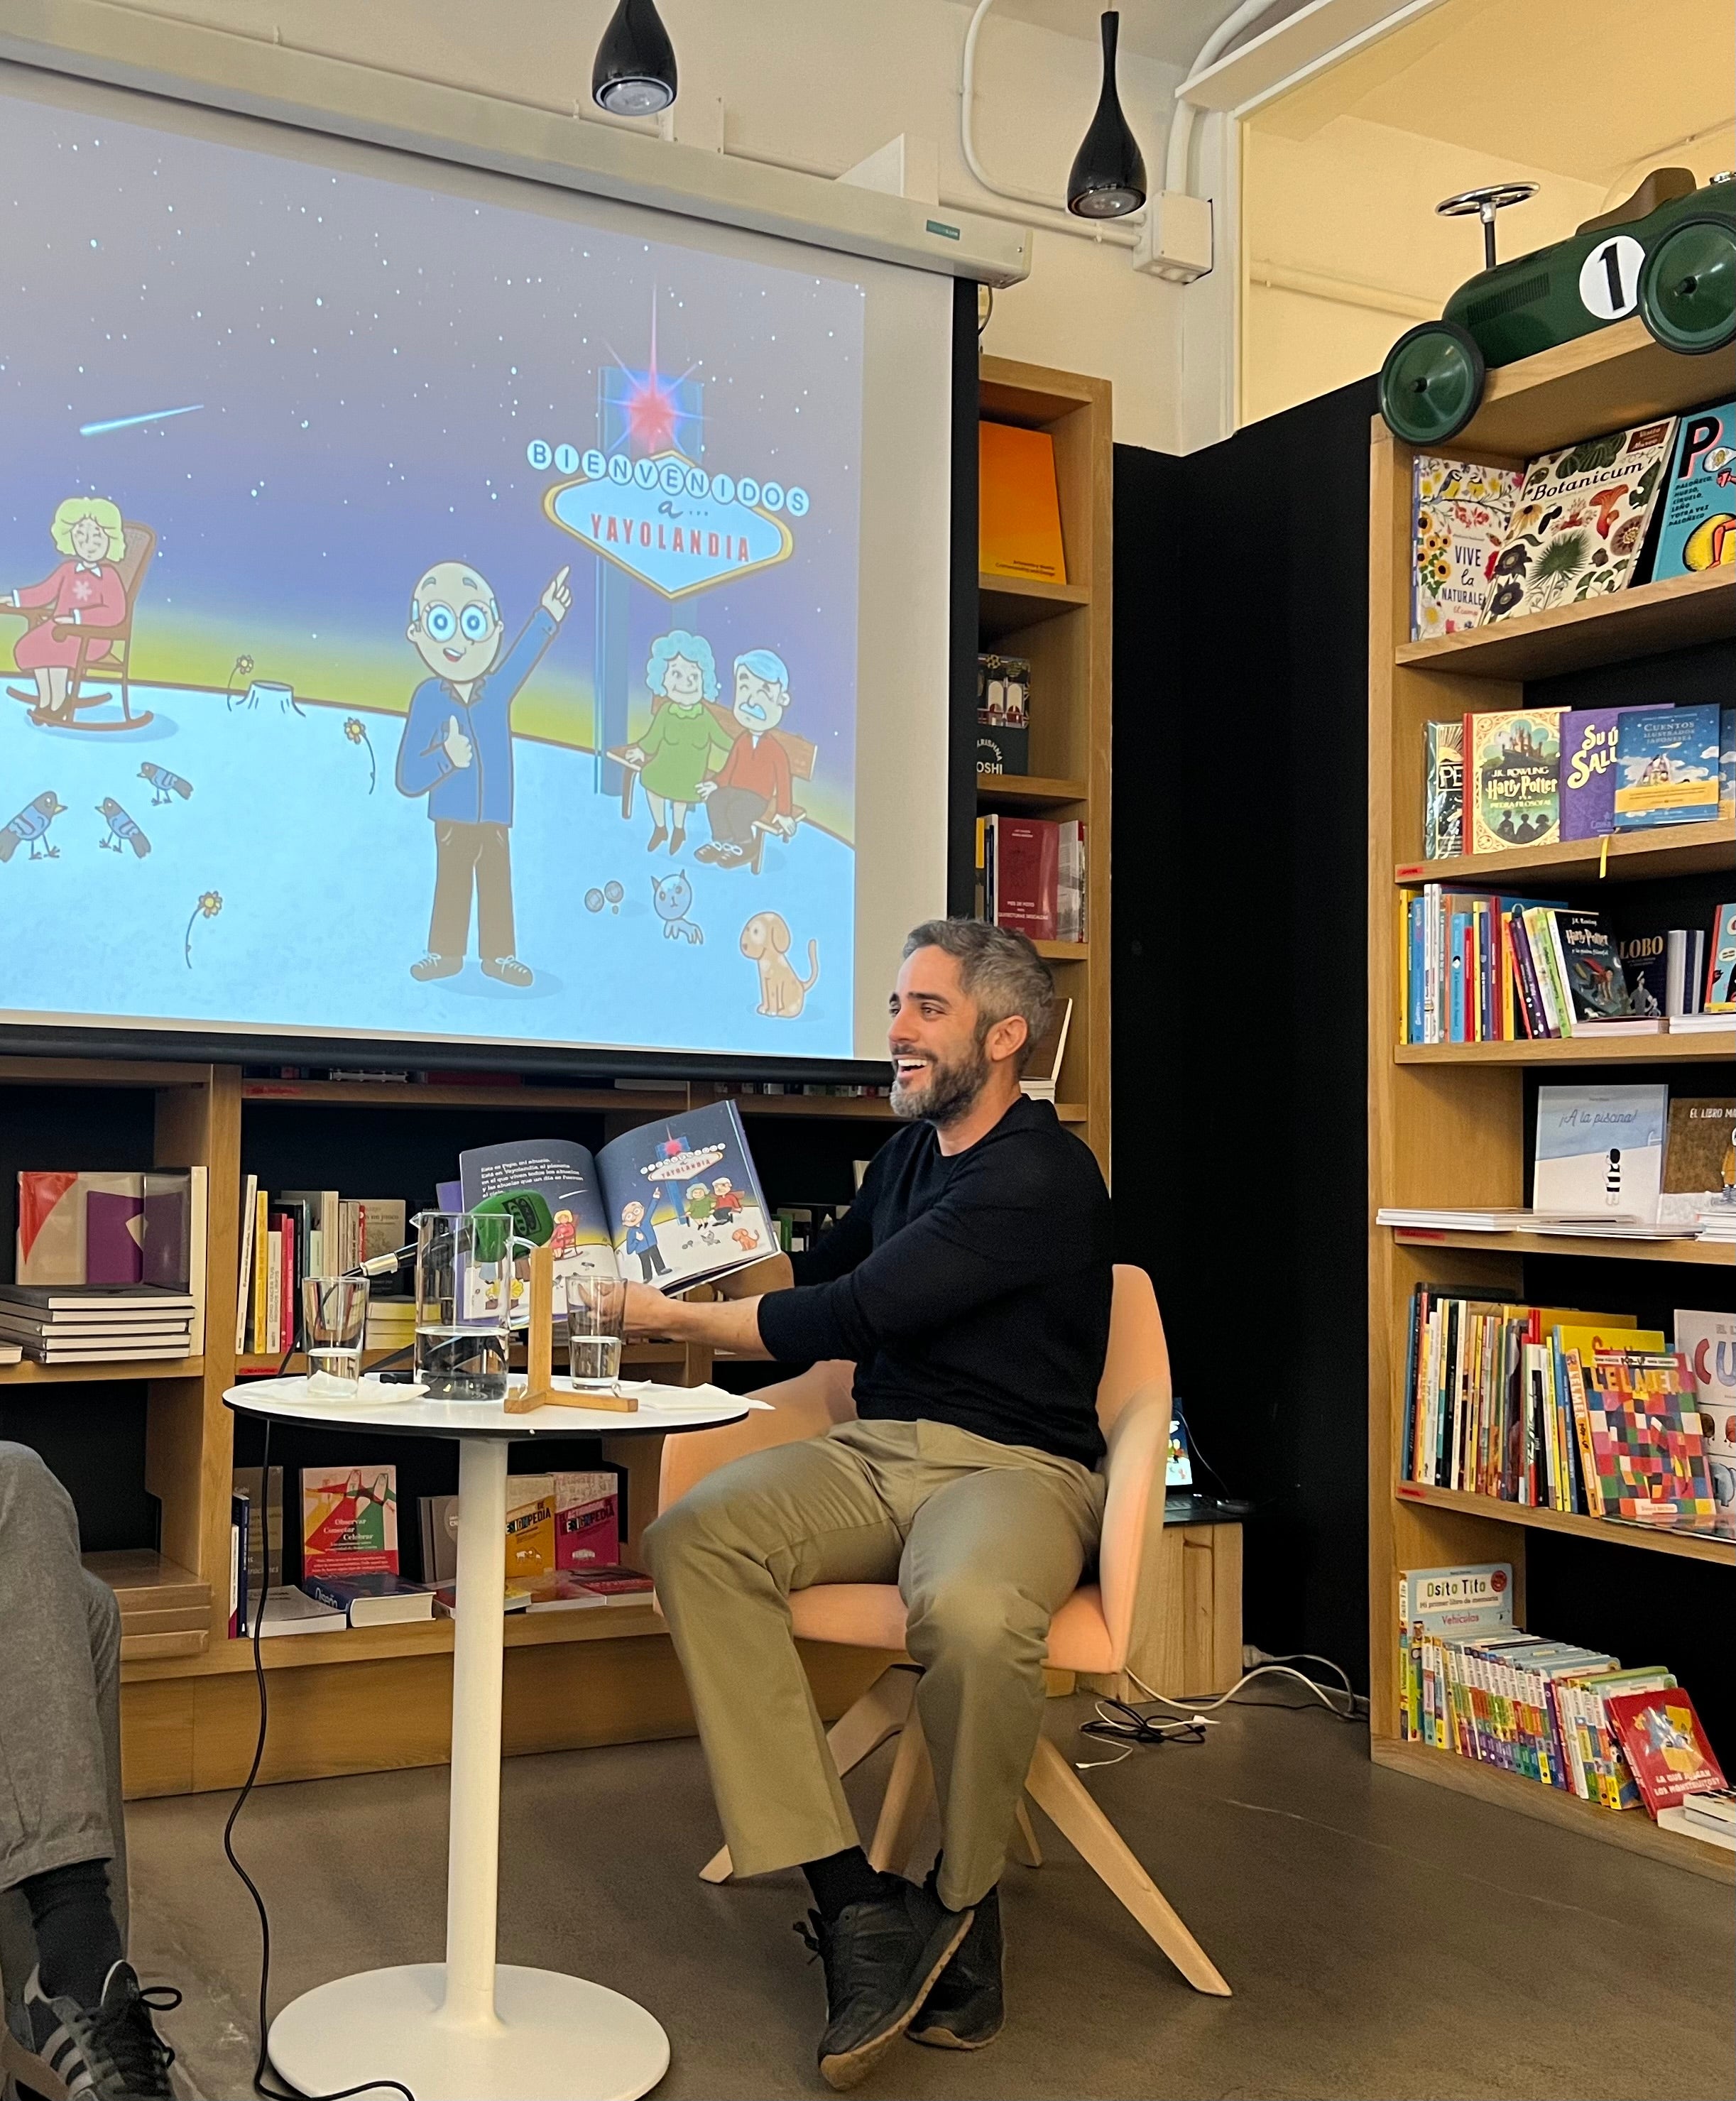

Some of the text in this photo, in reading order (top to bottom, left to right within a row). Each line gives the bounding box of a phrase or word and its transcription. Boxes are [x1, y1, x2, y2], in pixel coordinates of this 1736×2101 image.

[1598, 242, 1626, 311] 1
[533, 442, 805, 513] BIENVENIDOS
[1531, 462, 1644, 501] Botanicum
[591, 513, 750, 562] YAYOLANDIA
[1455, 545, 1481, 567] VIVE
[1461, 569, 1475, 586] la
[1442, 587, 1485, 606] NATURALE
[1644, 721, 1695, 732] CUENTOS
[976, 761, 1003, 775] OSHI
[1507, 766, 1549, 777] ROWLING
[1485, 775, 1558, 800] Harry Potter
[1566, 929, 1608, 948] Harry Potter
[1620, 936, 1664, 959] LOBO
[1580, 1112, 1590, 1123] la
[1690, 1108, 1700, 1119] EL
[1701, 1108, 1723, 1119] LIBRO
[661, 1159, 711, 1179] YAYOLANDIA
[1569, 1363, 1585, 1419] L'ELMER
[1591, 1367, 1683, 1395] L'ELMER
[1427, 1578, 1486, 1598] Osito Tito
[1654, 1787, 1669, 1796] LOS
